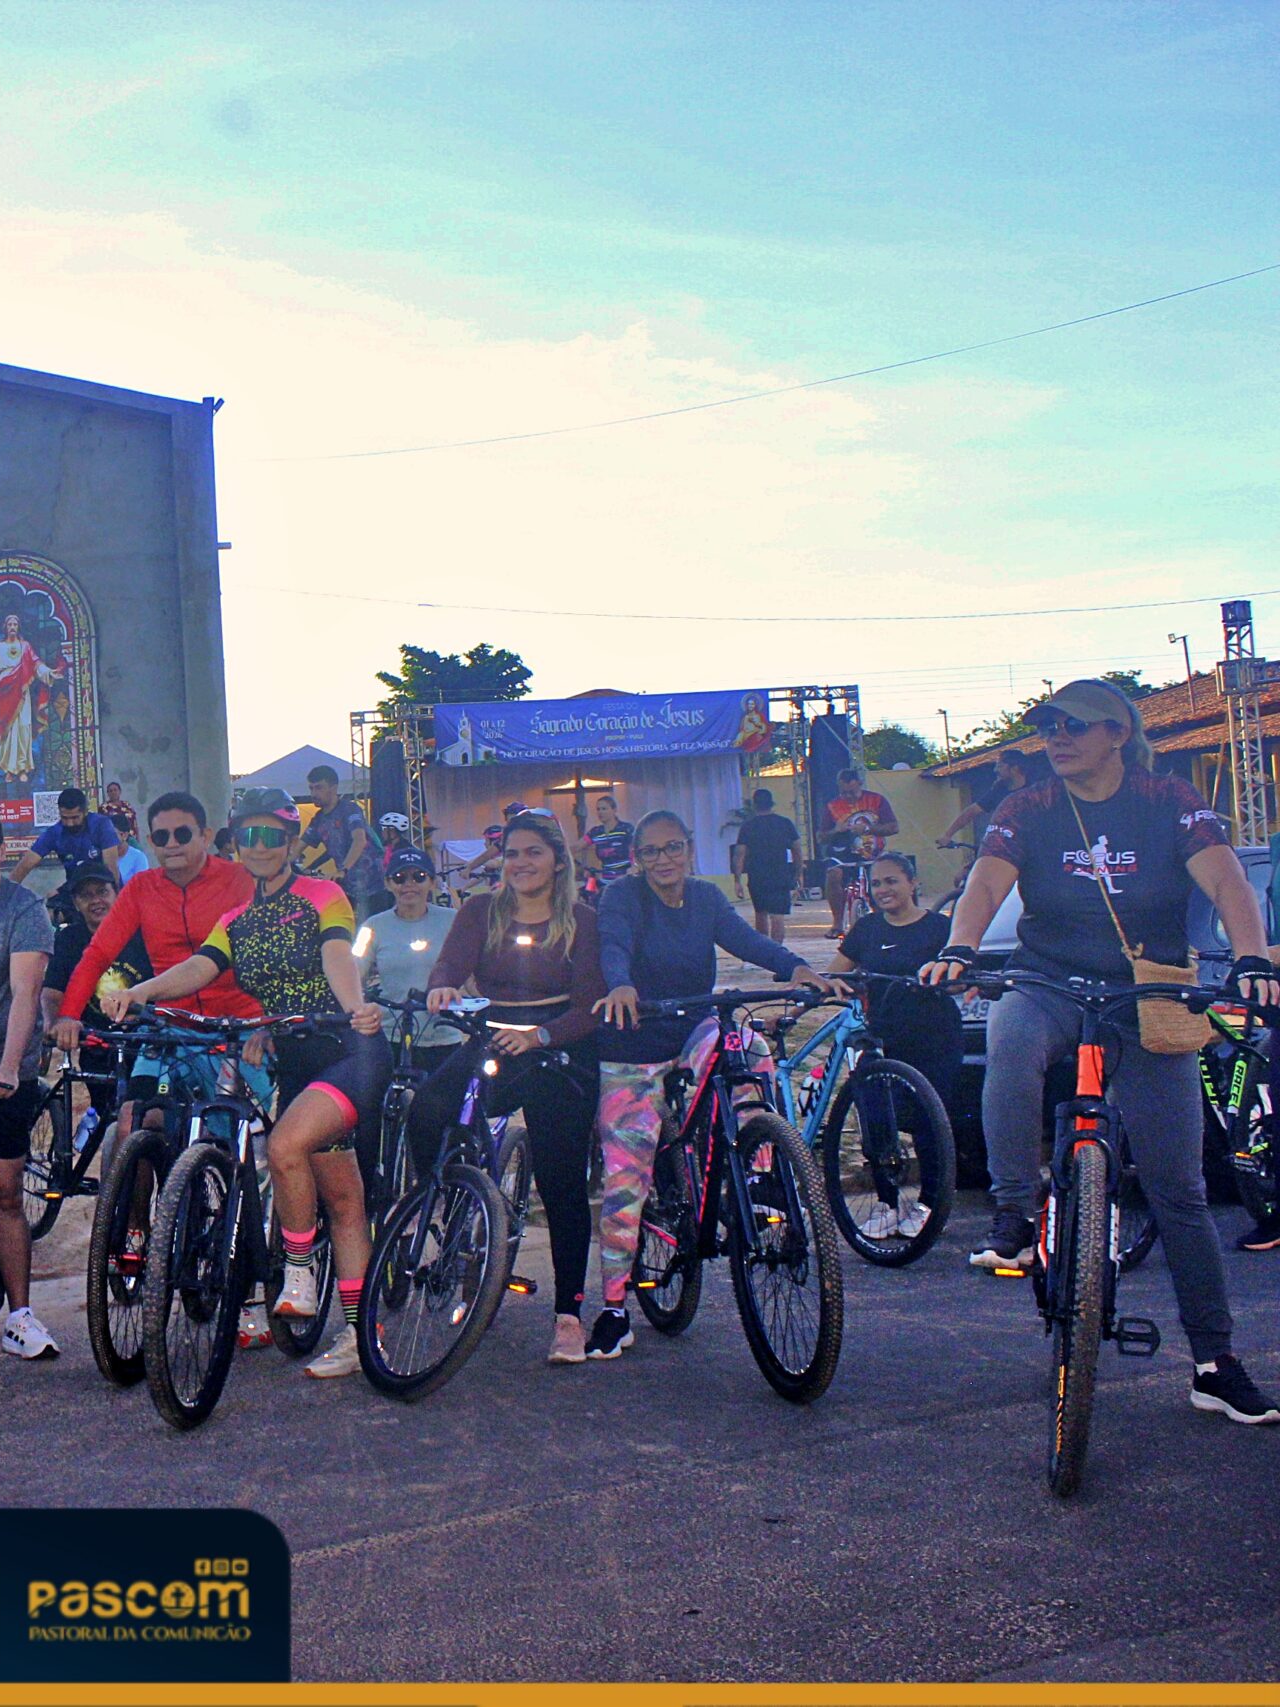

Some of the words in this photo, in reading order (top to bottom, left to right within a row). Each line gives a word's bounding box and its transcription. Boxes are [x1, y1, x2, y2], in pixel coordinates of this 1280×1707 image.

[530, 710, 584, 736] Sagrado
[585, 711, 638, 734] Coração
[640, 710, 655, 729] de
[657, 698, 705, 730] Jesus
[1230, 1064, 1244, 1104] RACE
